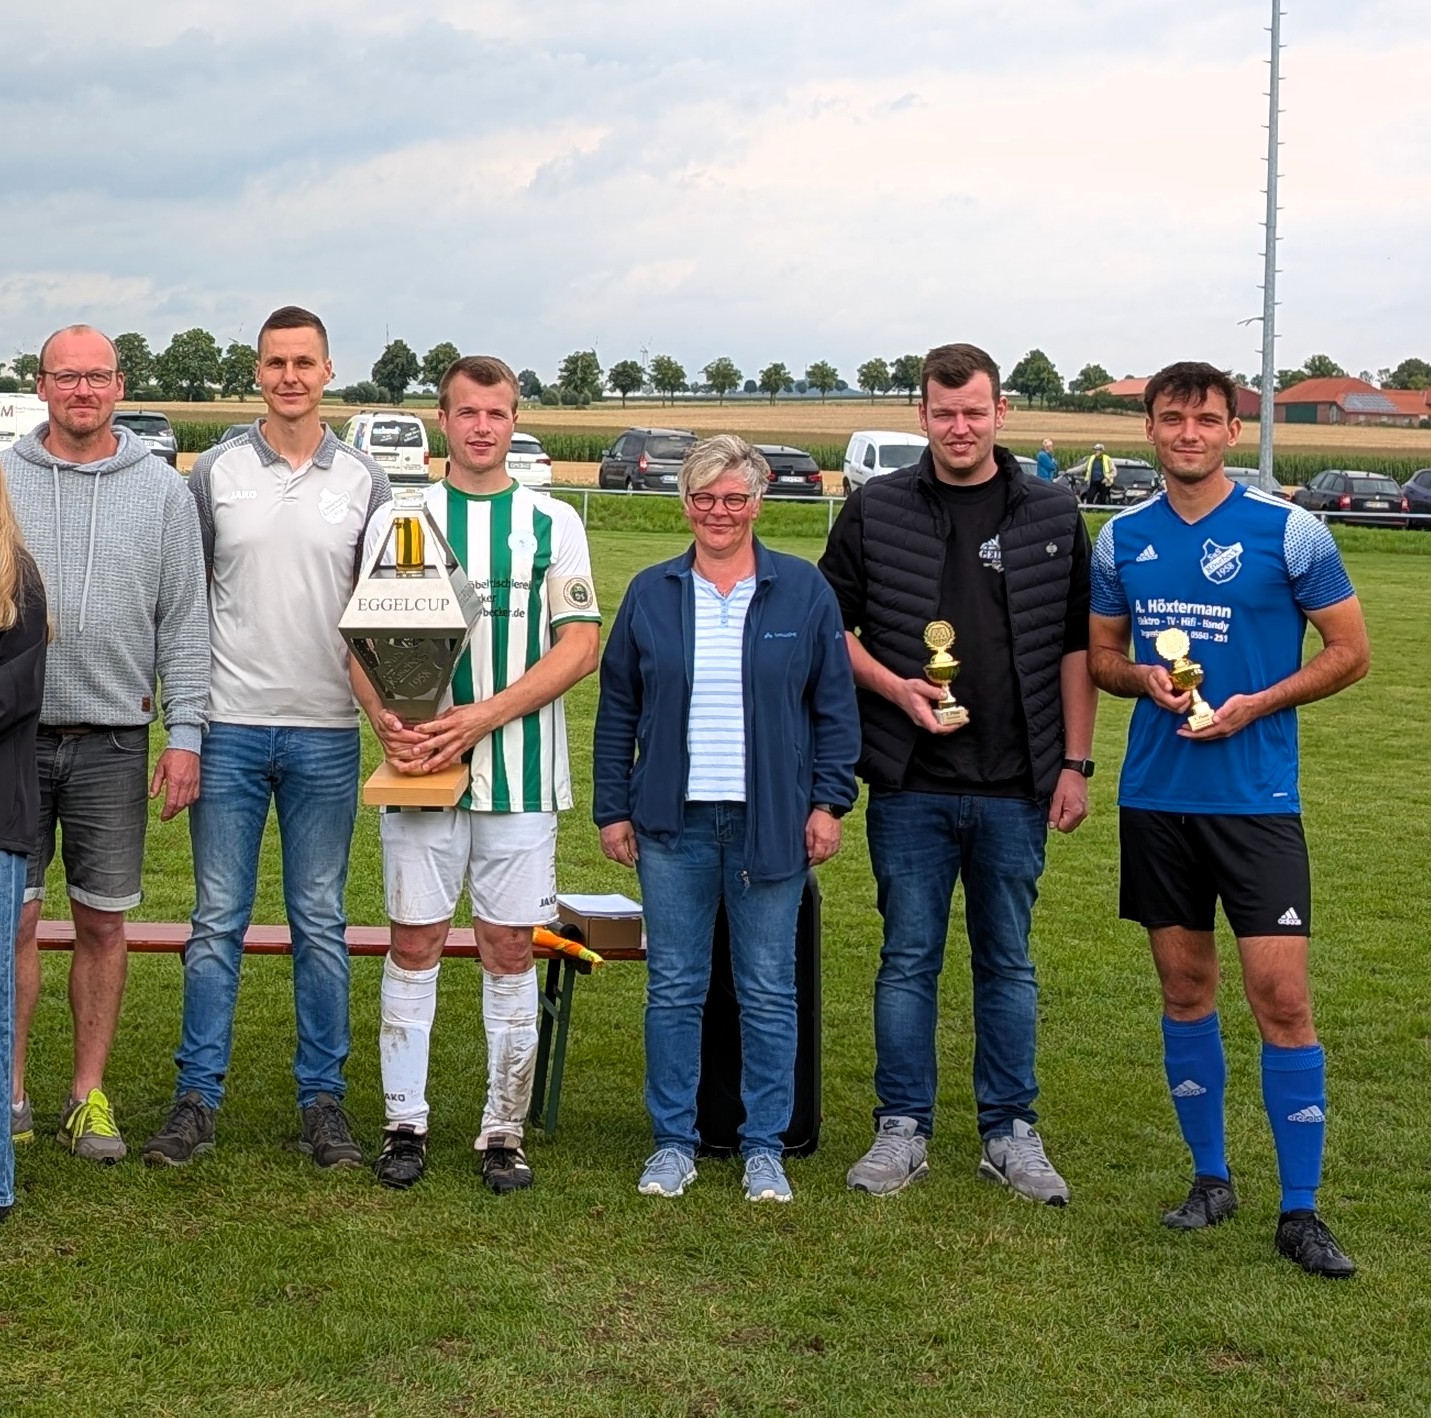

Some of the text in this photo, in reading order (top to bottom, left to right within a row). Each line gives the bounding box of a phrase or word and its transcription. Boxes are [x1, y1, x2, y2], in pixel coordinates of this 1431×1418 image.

[357, 598, 450, 612] EGGELCUP
[1148, 599, 1231, 618] Höxtermann
[1166, 616, 1176, 626] TV
[384, 1092, 406, 1103] AKO
